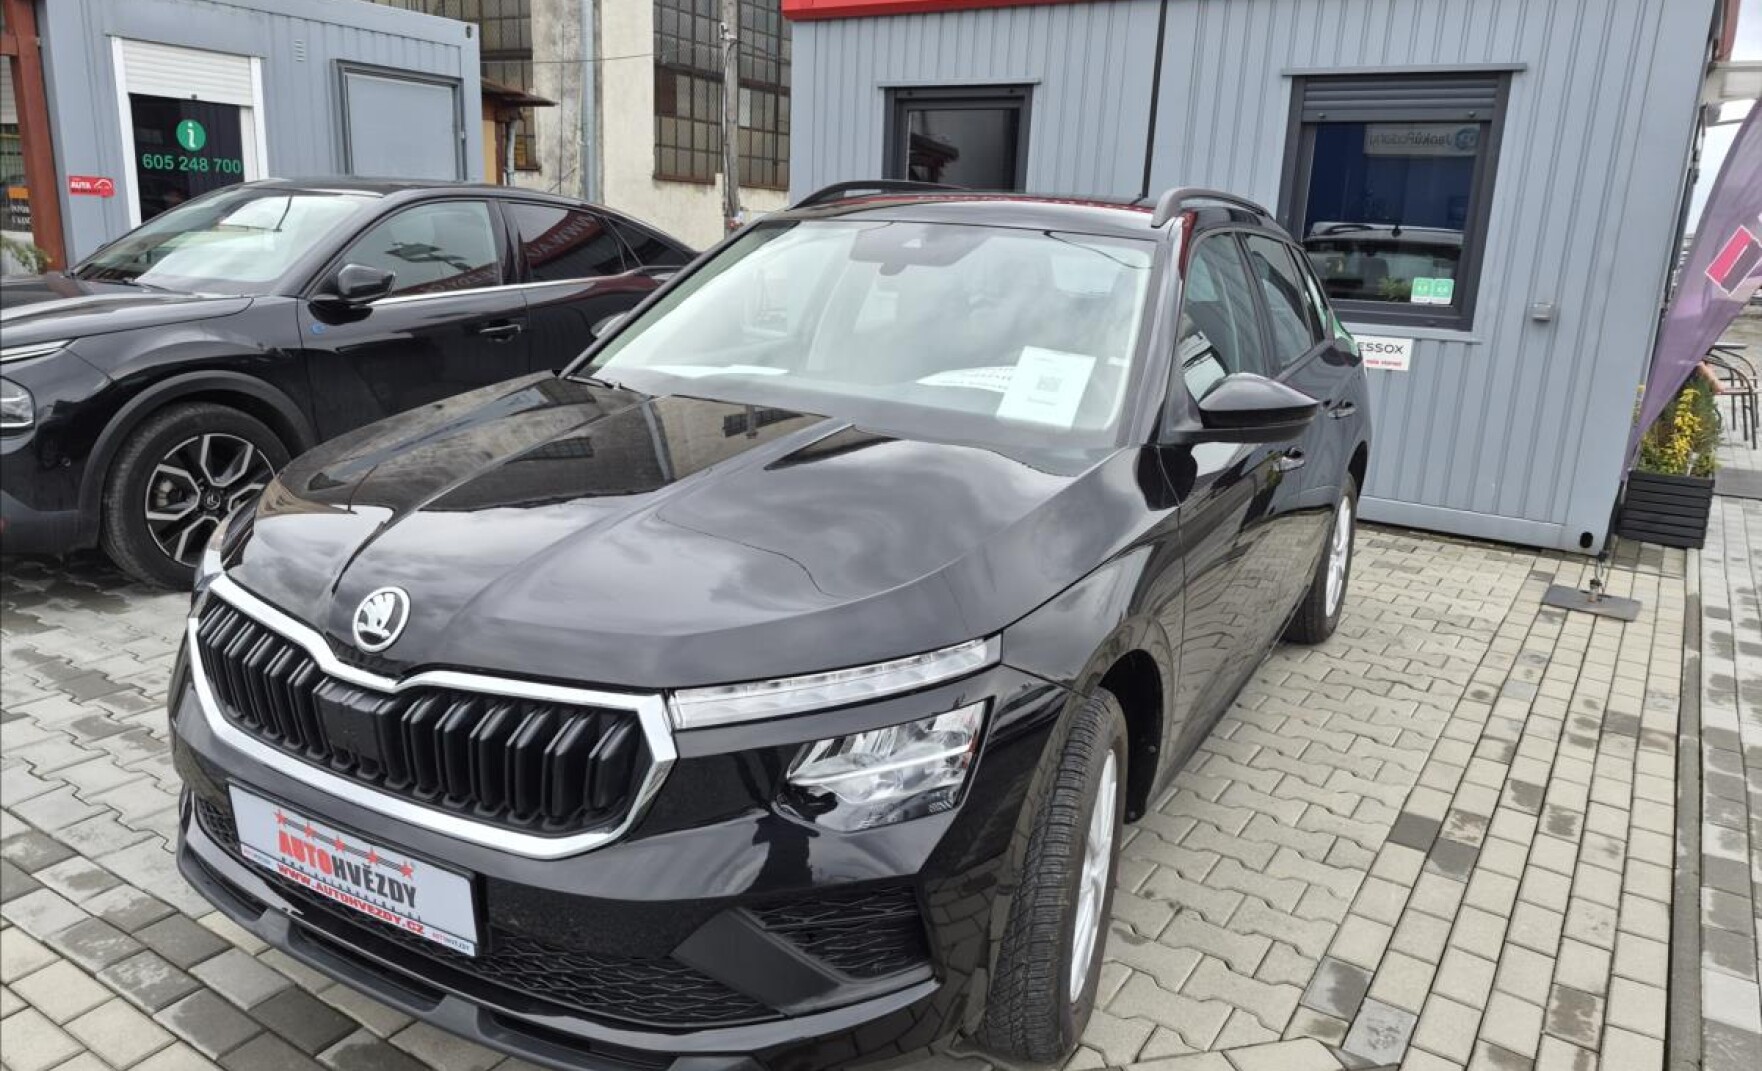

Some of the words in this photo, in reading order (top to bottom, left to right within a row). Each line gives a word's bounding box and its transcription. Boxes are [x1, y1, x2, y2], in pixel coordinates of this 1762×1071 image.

[142, 154, 174, 170] 605
[178, 156, 209, 172] 248
[212, 158, 242, 174] 700
[1357, 341, 1405, 355] ESSOX
